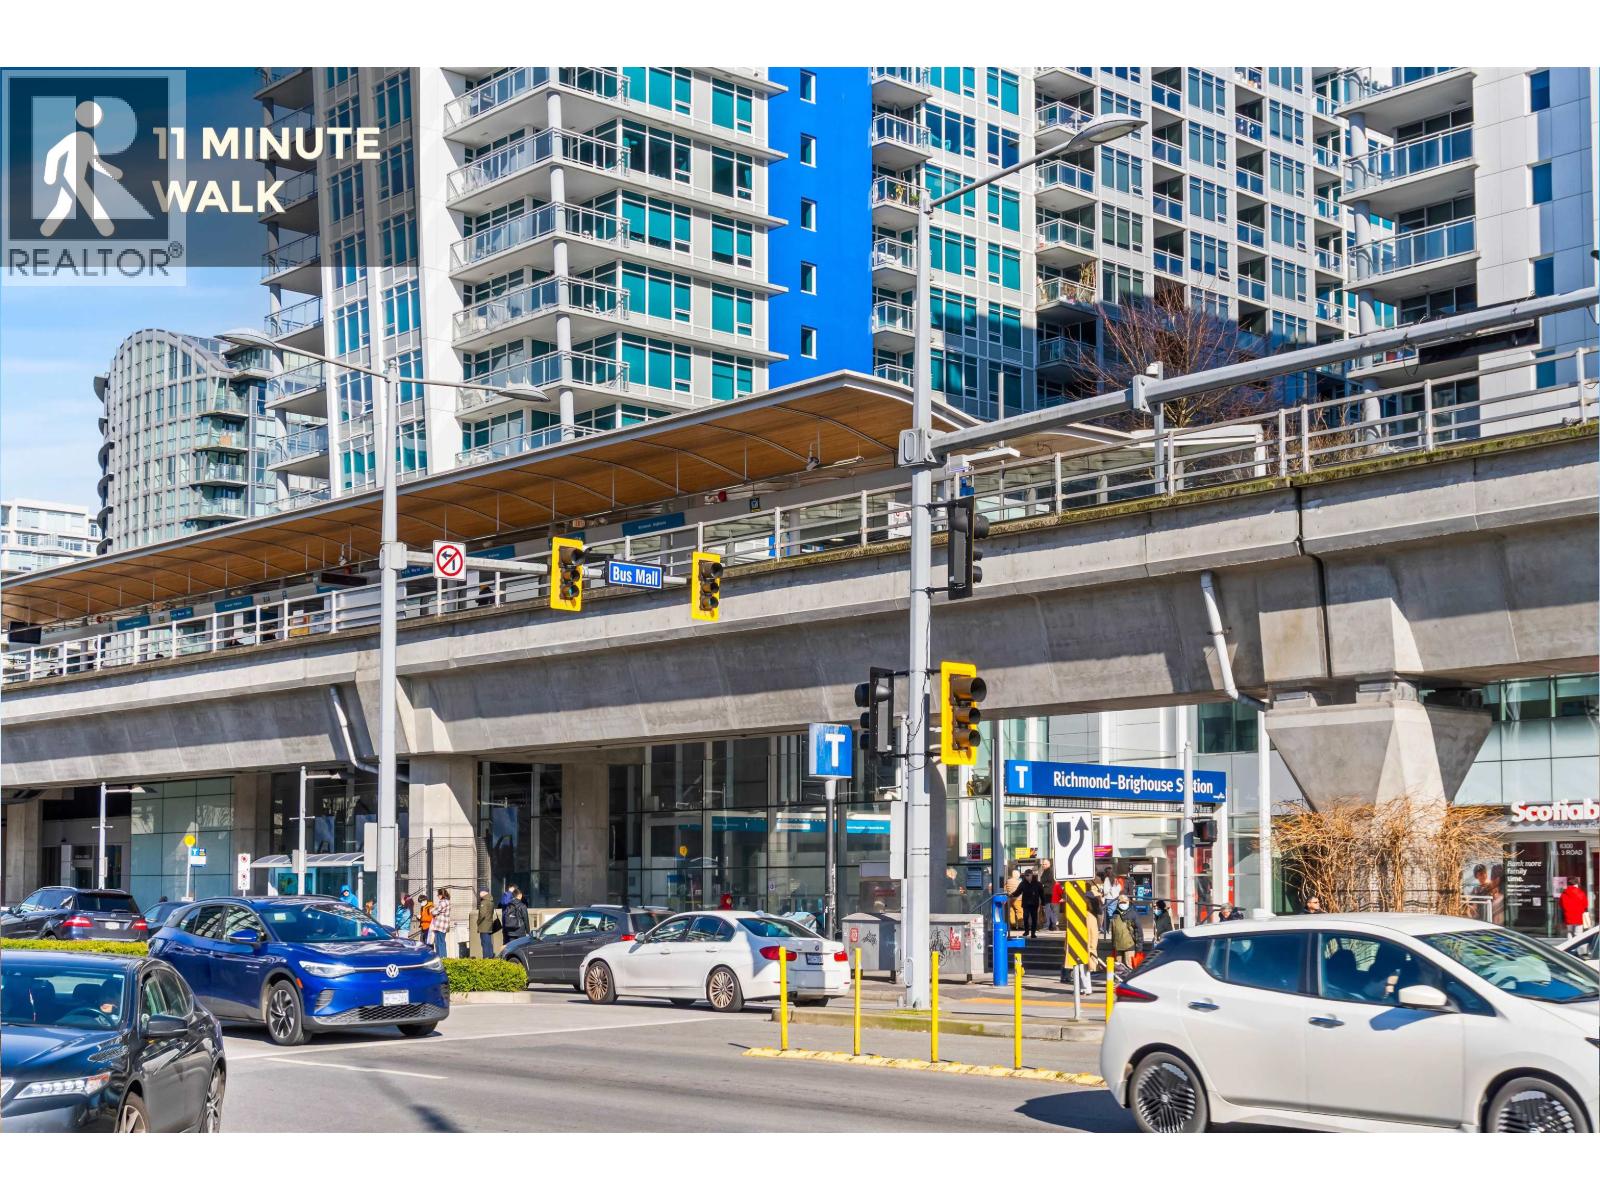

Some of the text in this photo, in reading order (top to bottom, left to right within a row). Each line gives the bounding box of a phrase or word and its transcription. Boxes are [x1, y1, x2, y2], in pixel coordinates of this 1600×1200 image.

[613, 566, 658, 585] Bus Mall
[825, 733, 846, 768] T
[1014, 765, 1029, 789] T
[1176, 777, 1213, 794] Stion
